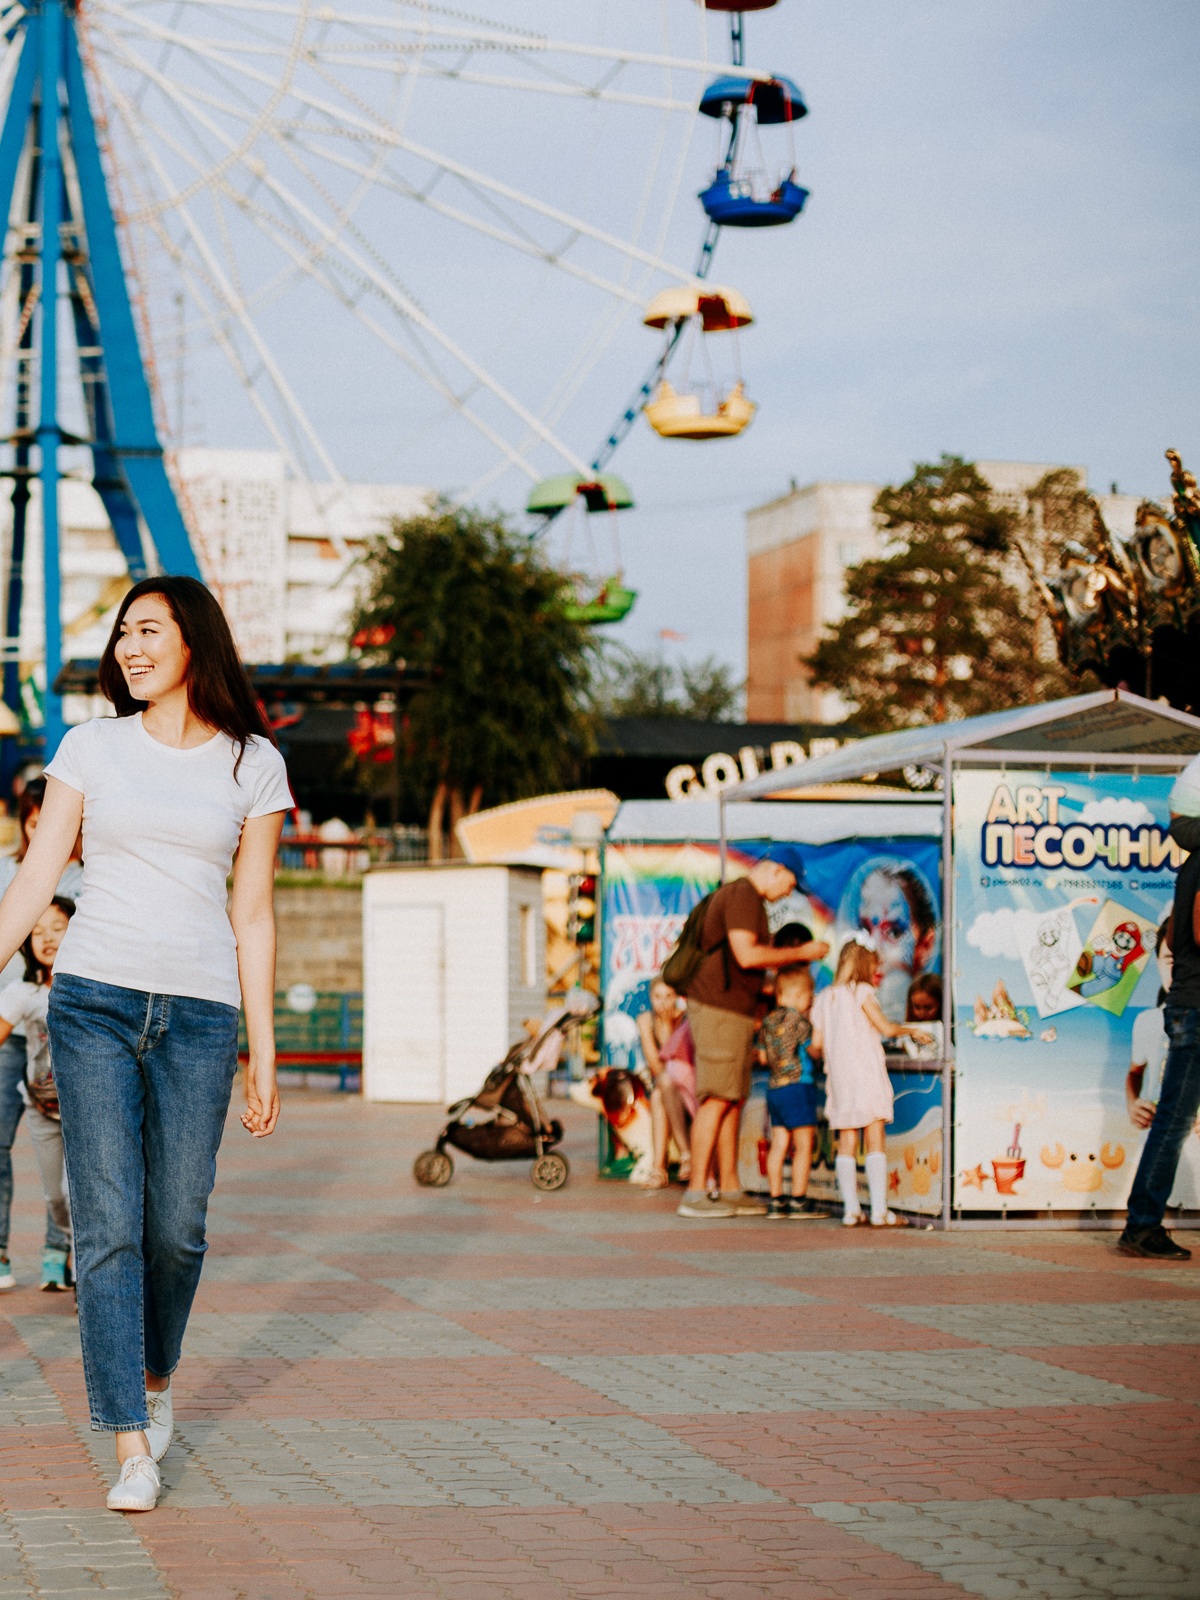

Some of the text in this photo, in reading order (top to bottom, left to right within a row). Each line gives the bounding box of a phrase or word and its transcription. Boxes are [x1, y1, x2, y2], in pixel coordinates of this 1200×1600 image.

[665, 737, 860, 802] GOLD
[986, 784, 1067, 825] ART
[984, 822, 1191, 869] ПЕСОЧНИ
